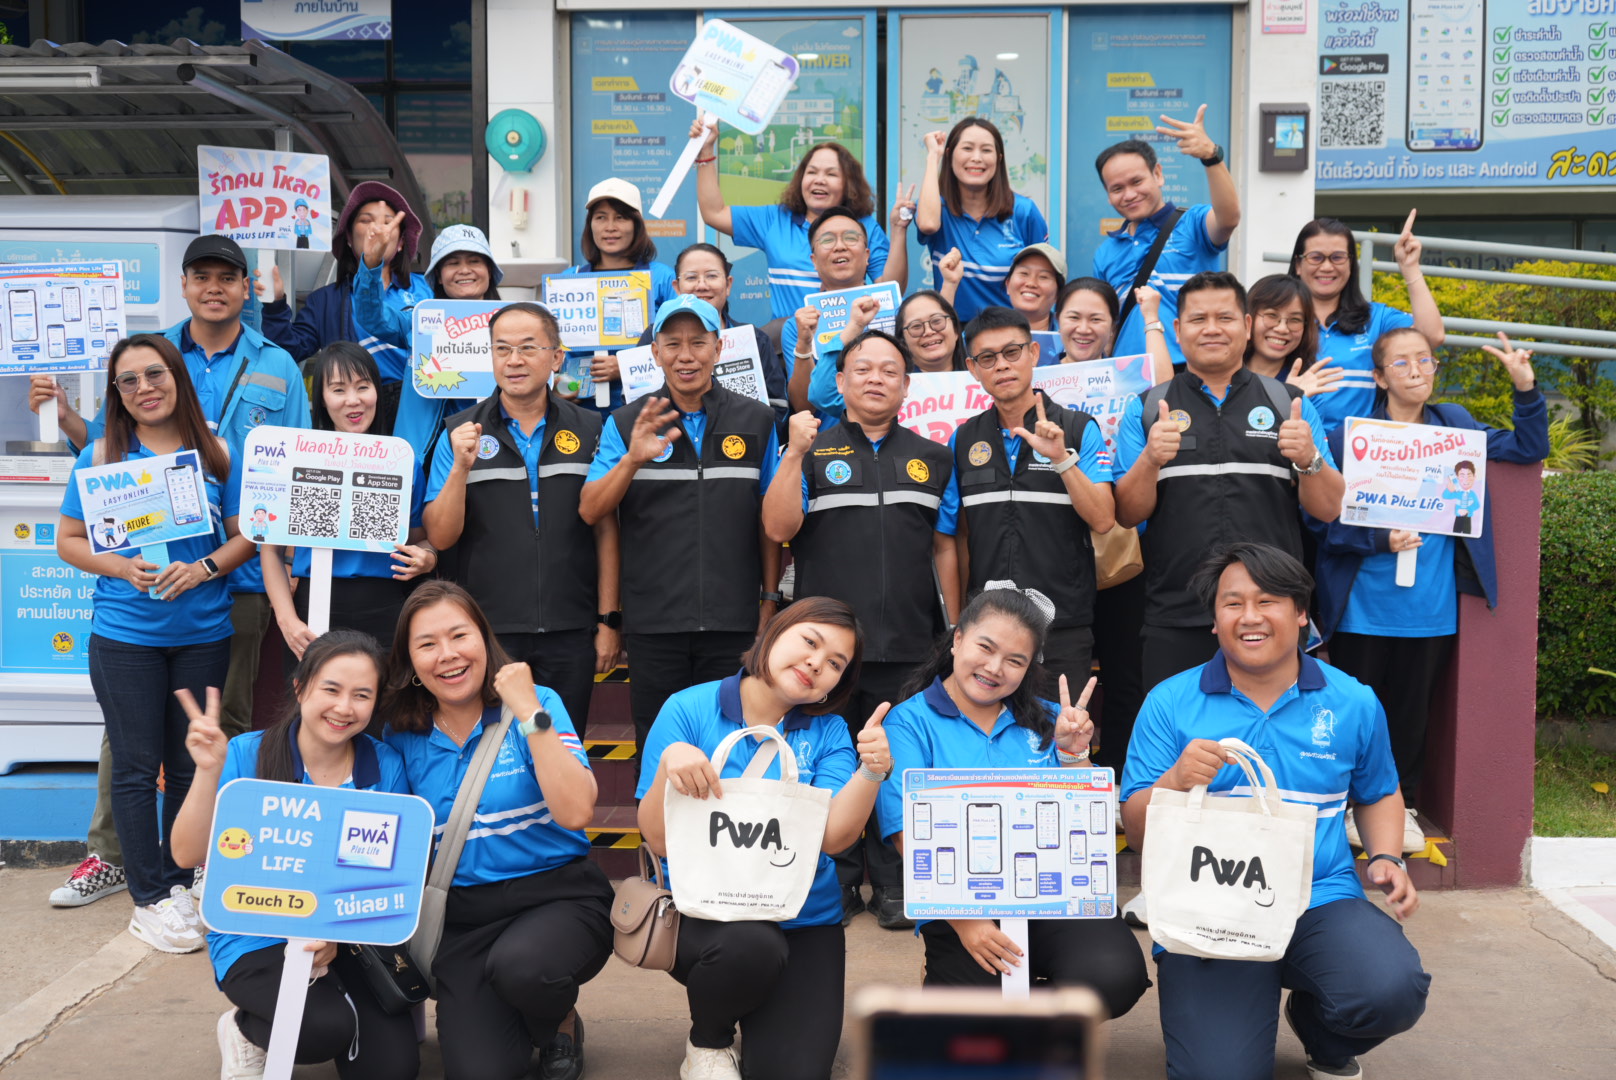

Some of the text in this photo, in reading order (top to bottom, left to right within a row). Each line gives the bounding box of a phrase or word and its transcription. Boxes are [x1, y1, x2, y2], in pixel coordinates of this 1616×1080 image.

[1324, 2, 1400, 23] พร้อมใช้งาน
[703, 25, 744, 58] PWA
[1340, 62, 1385, 73] Google Play
[1316, 156, 1537, 180] ได้แล้ววันนี้ ทั้ง ios และ Android
[208, 165, 321, 200] รักคน โหลด
[215, 196, 288, 231] APP
[236, 231, 256, 240] PLUS
[258, 231, 275, 239] LIFE
[600, 279, 629, 289] PWA
[549, 291, 595, 303] สะดวก
[820, 295, 847, 309] PWA
[421, 316, 442, 325] PWA
[823, 308, 846, 319] PLUS
[827, 320, 847, 329] LIFE
[629, 362, 656, 376] PWA
[1088, 375, 1111, 386] PWA
[254, 445, 286, 458] PWA
[1369, 431, 1467, 462] ประปาใกล้ฉัน
[257, 458, 280, 467] Plus Life
[1425, 466, 1442, 474] PWA
[85, 471, 138, 495] PWA
[305, 473, 341, 483] Google Play
[103, 495, 121, 507] EASY
[123, 487, 150, 501] ONLINE
[1355, 490, 1444, 511] PWA Plus Life
[117, 515, 151, 535] FEATURE
[32, 566, 74, 579] สะดวก
[20, 584, 72, 599] ประหยัด
[261, 795, 323, 822] PWA
[259, 826, 314, 848] PLUS
[347, 826, 389, 845] PWA
[709, 810, 782, 850] PWA
[350, 844, 380, 856] Plus Life
[261, 855, 307, 874] LIFE
[1190, 845, 1266, 890] PWA
[236, 891, 304, 909] Touch ไว
[334, 892, 405, 917] ใช่เลย !!
